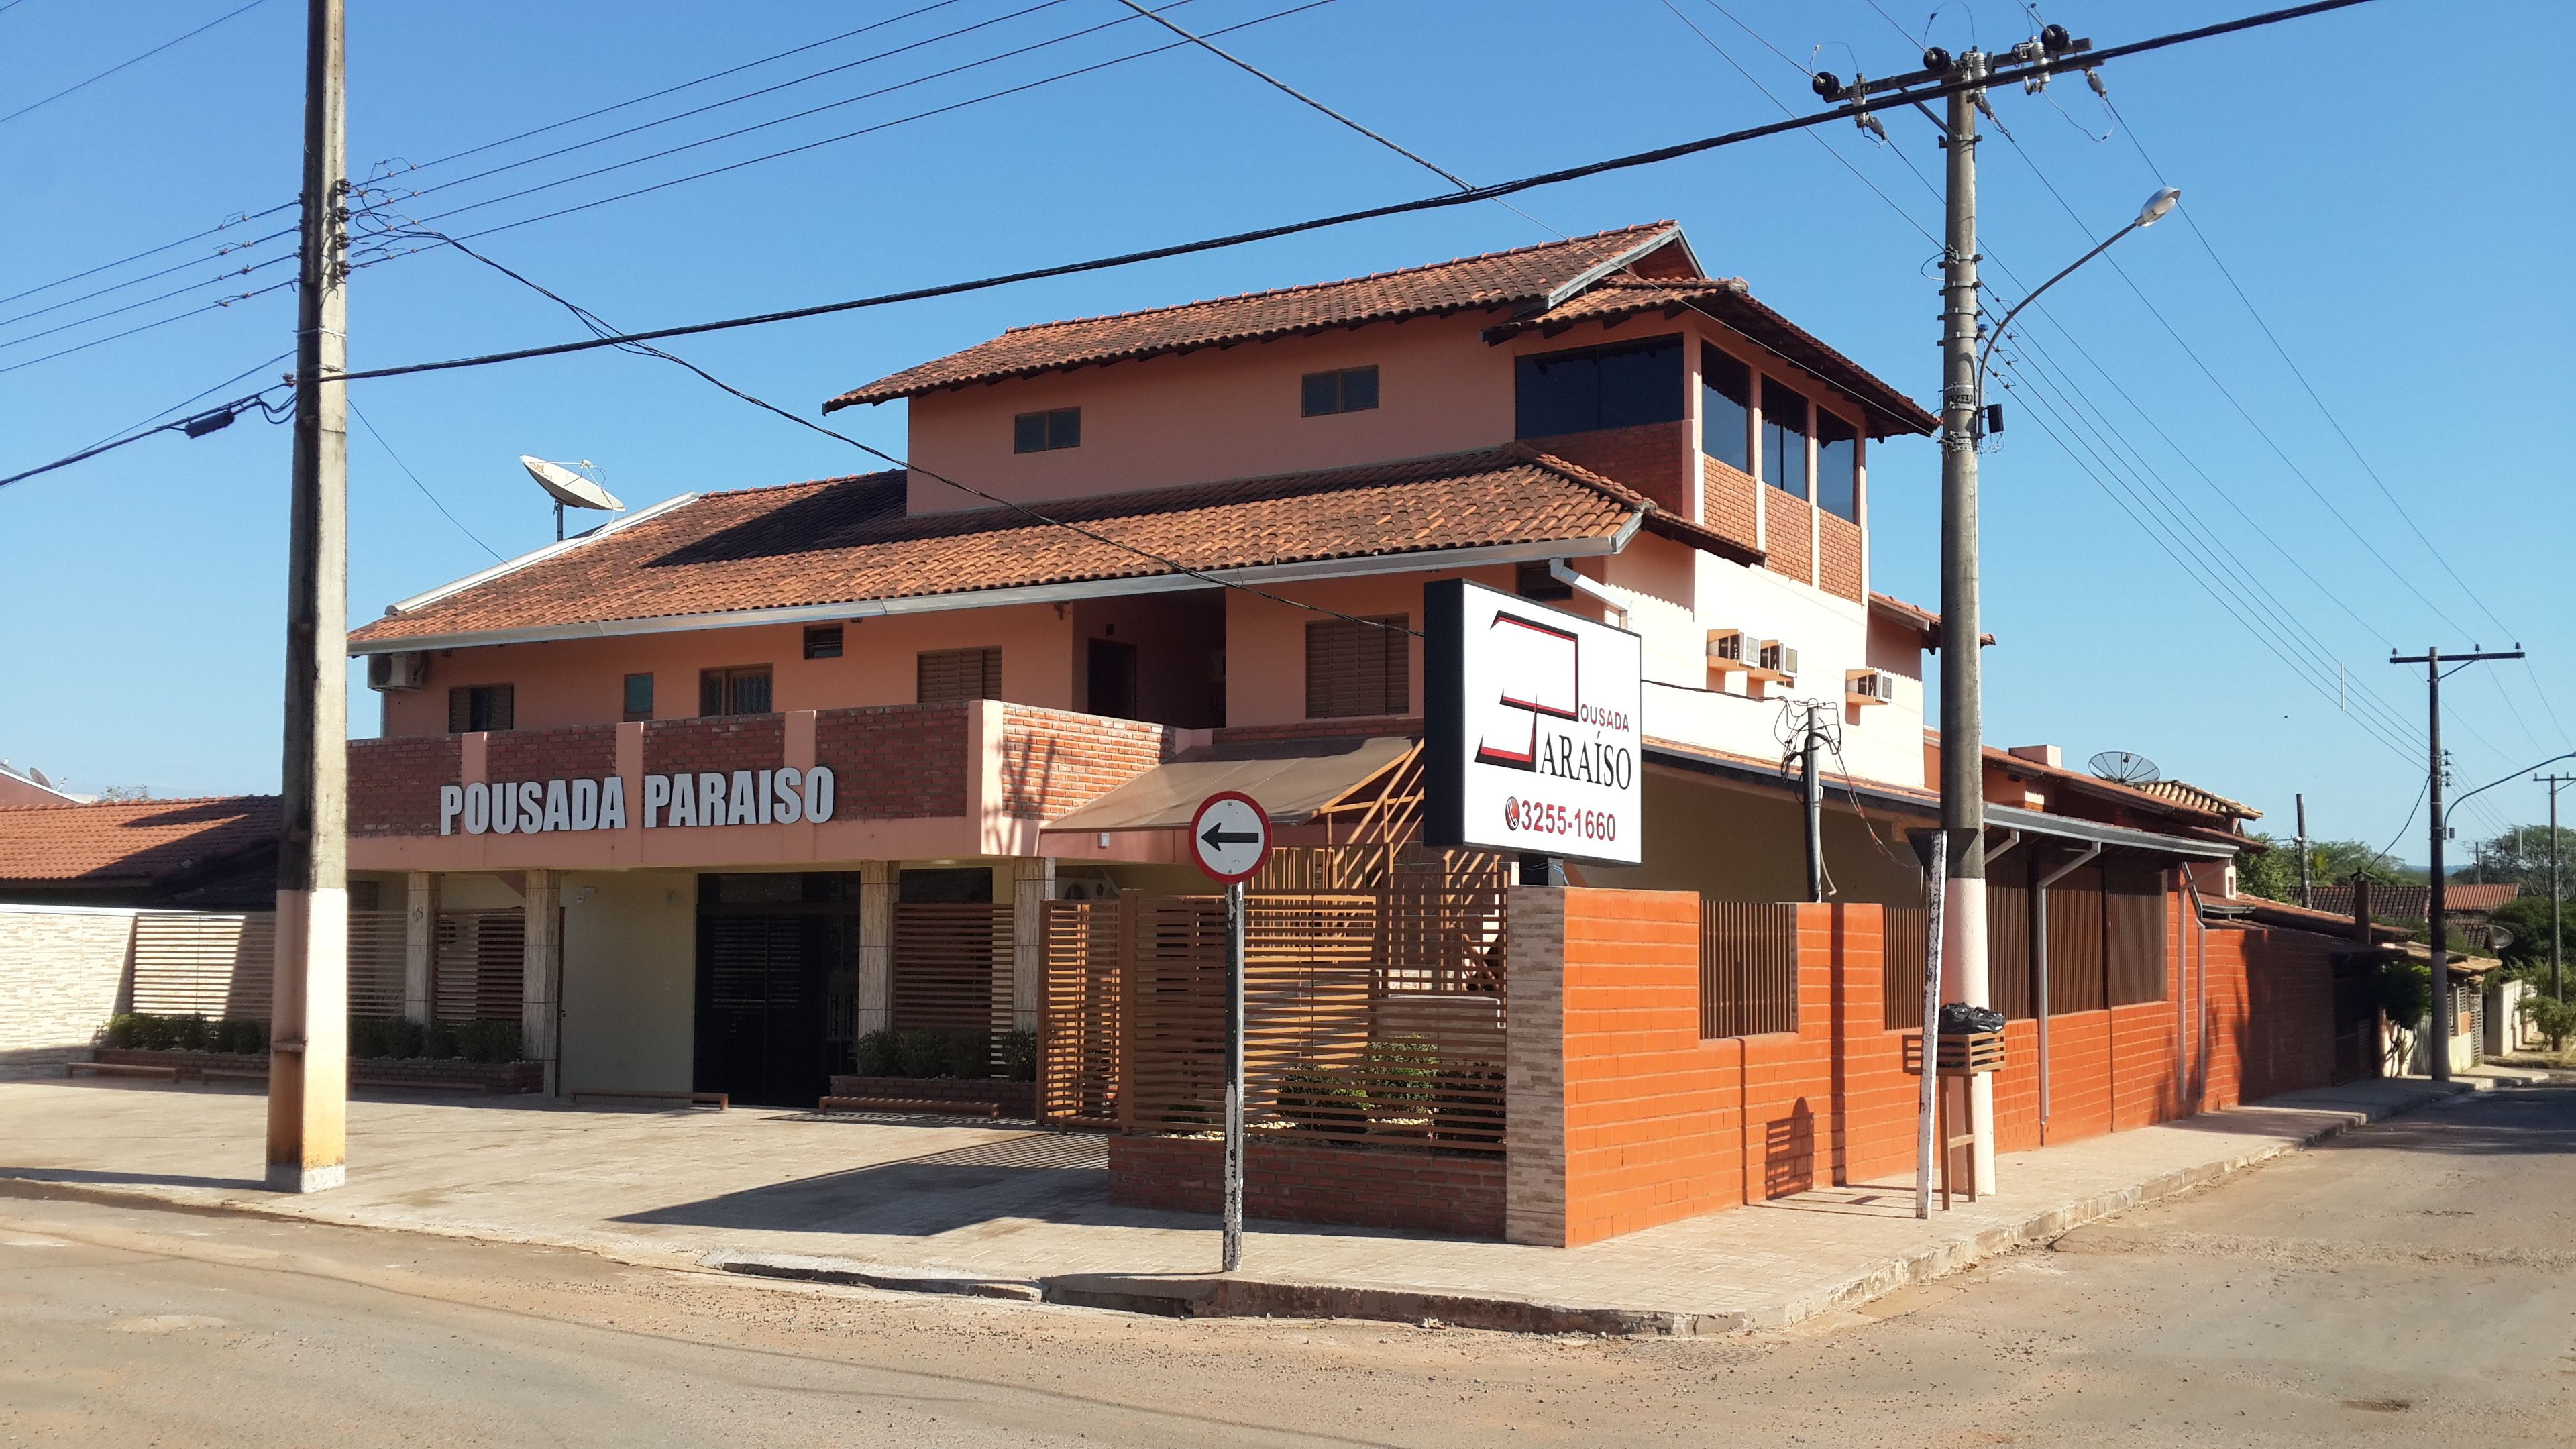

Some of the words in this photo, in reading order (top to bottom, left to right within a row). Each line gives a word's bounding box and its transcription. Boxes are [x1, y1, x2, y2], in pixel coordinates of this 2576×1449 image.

[441, 776, 627, 836] POUSADA
[644, 766, 835, 828] PARAISO
[1521, 800, 1616, 842] 3255-1660
